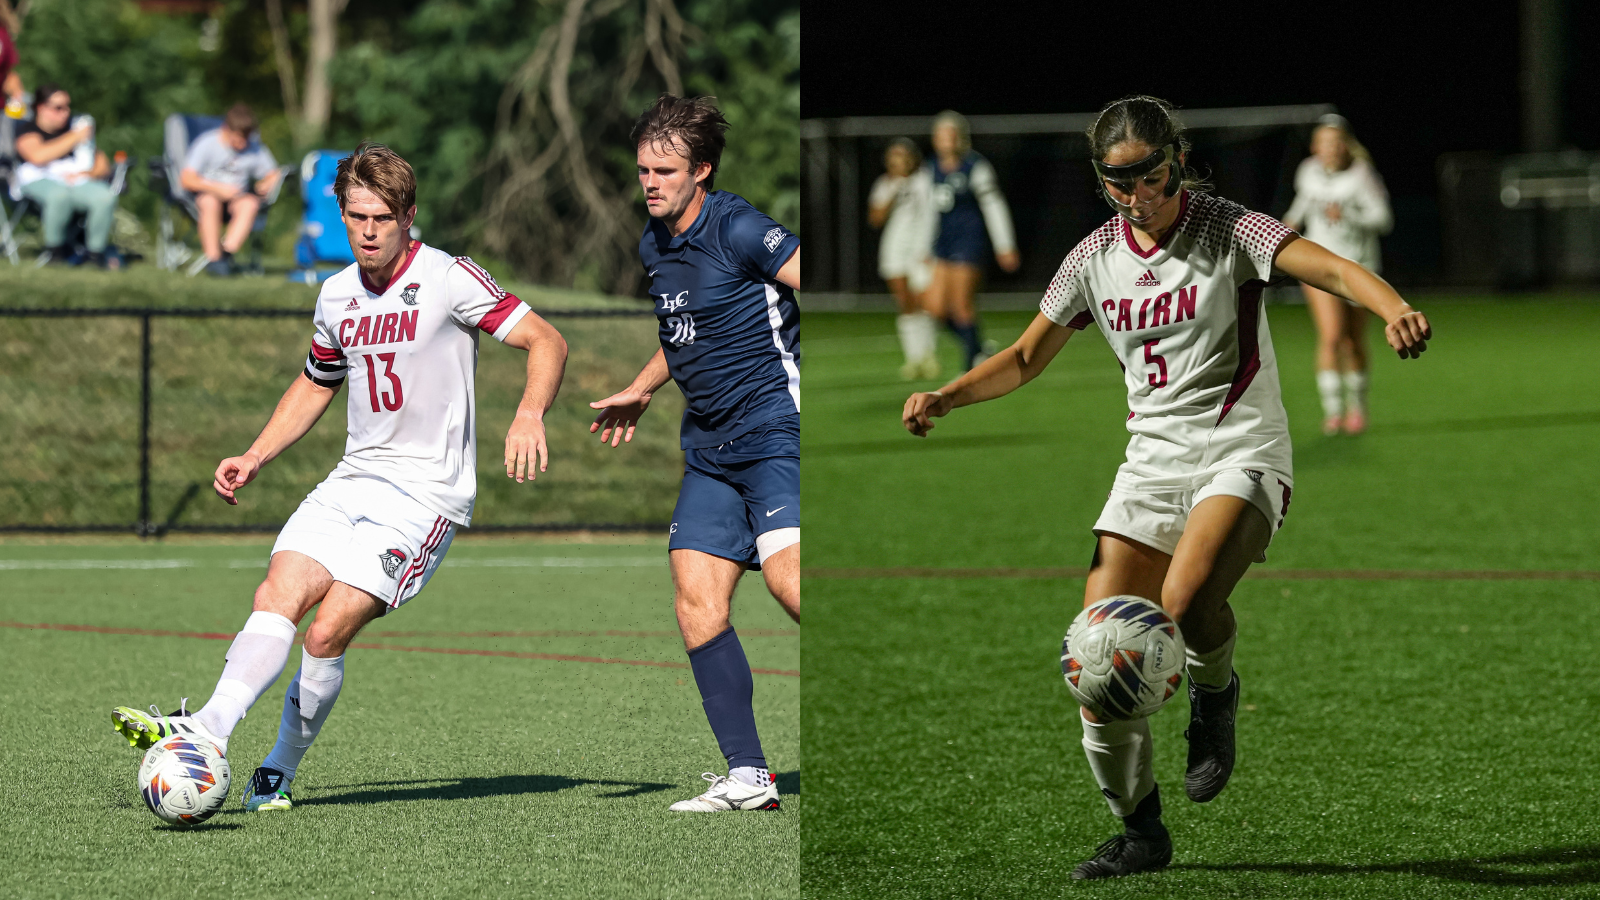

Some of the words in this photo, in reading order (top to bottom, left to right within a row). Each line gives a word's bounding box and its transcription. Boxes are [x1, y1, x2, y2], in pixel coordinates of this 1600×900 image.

[339, 309, 419, 348] CAIRN
[1101, 285, 1198, 331] CAIRN
[362, 352, 404, 413] 13
[1142, 337, 1167, 389] 5
[1154, 640, 1164, 670] CAIRN
